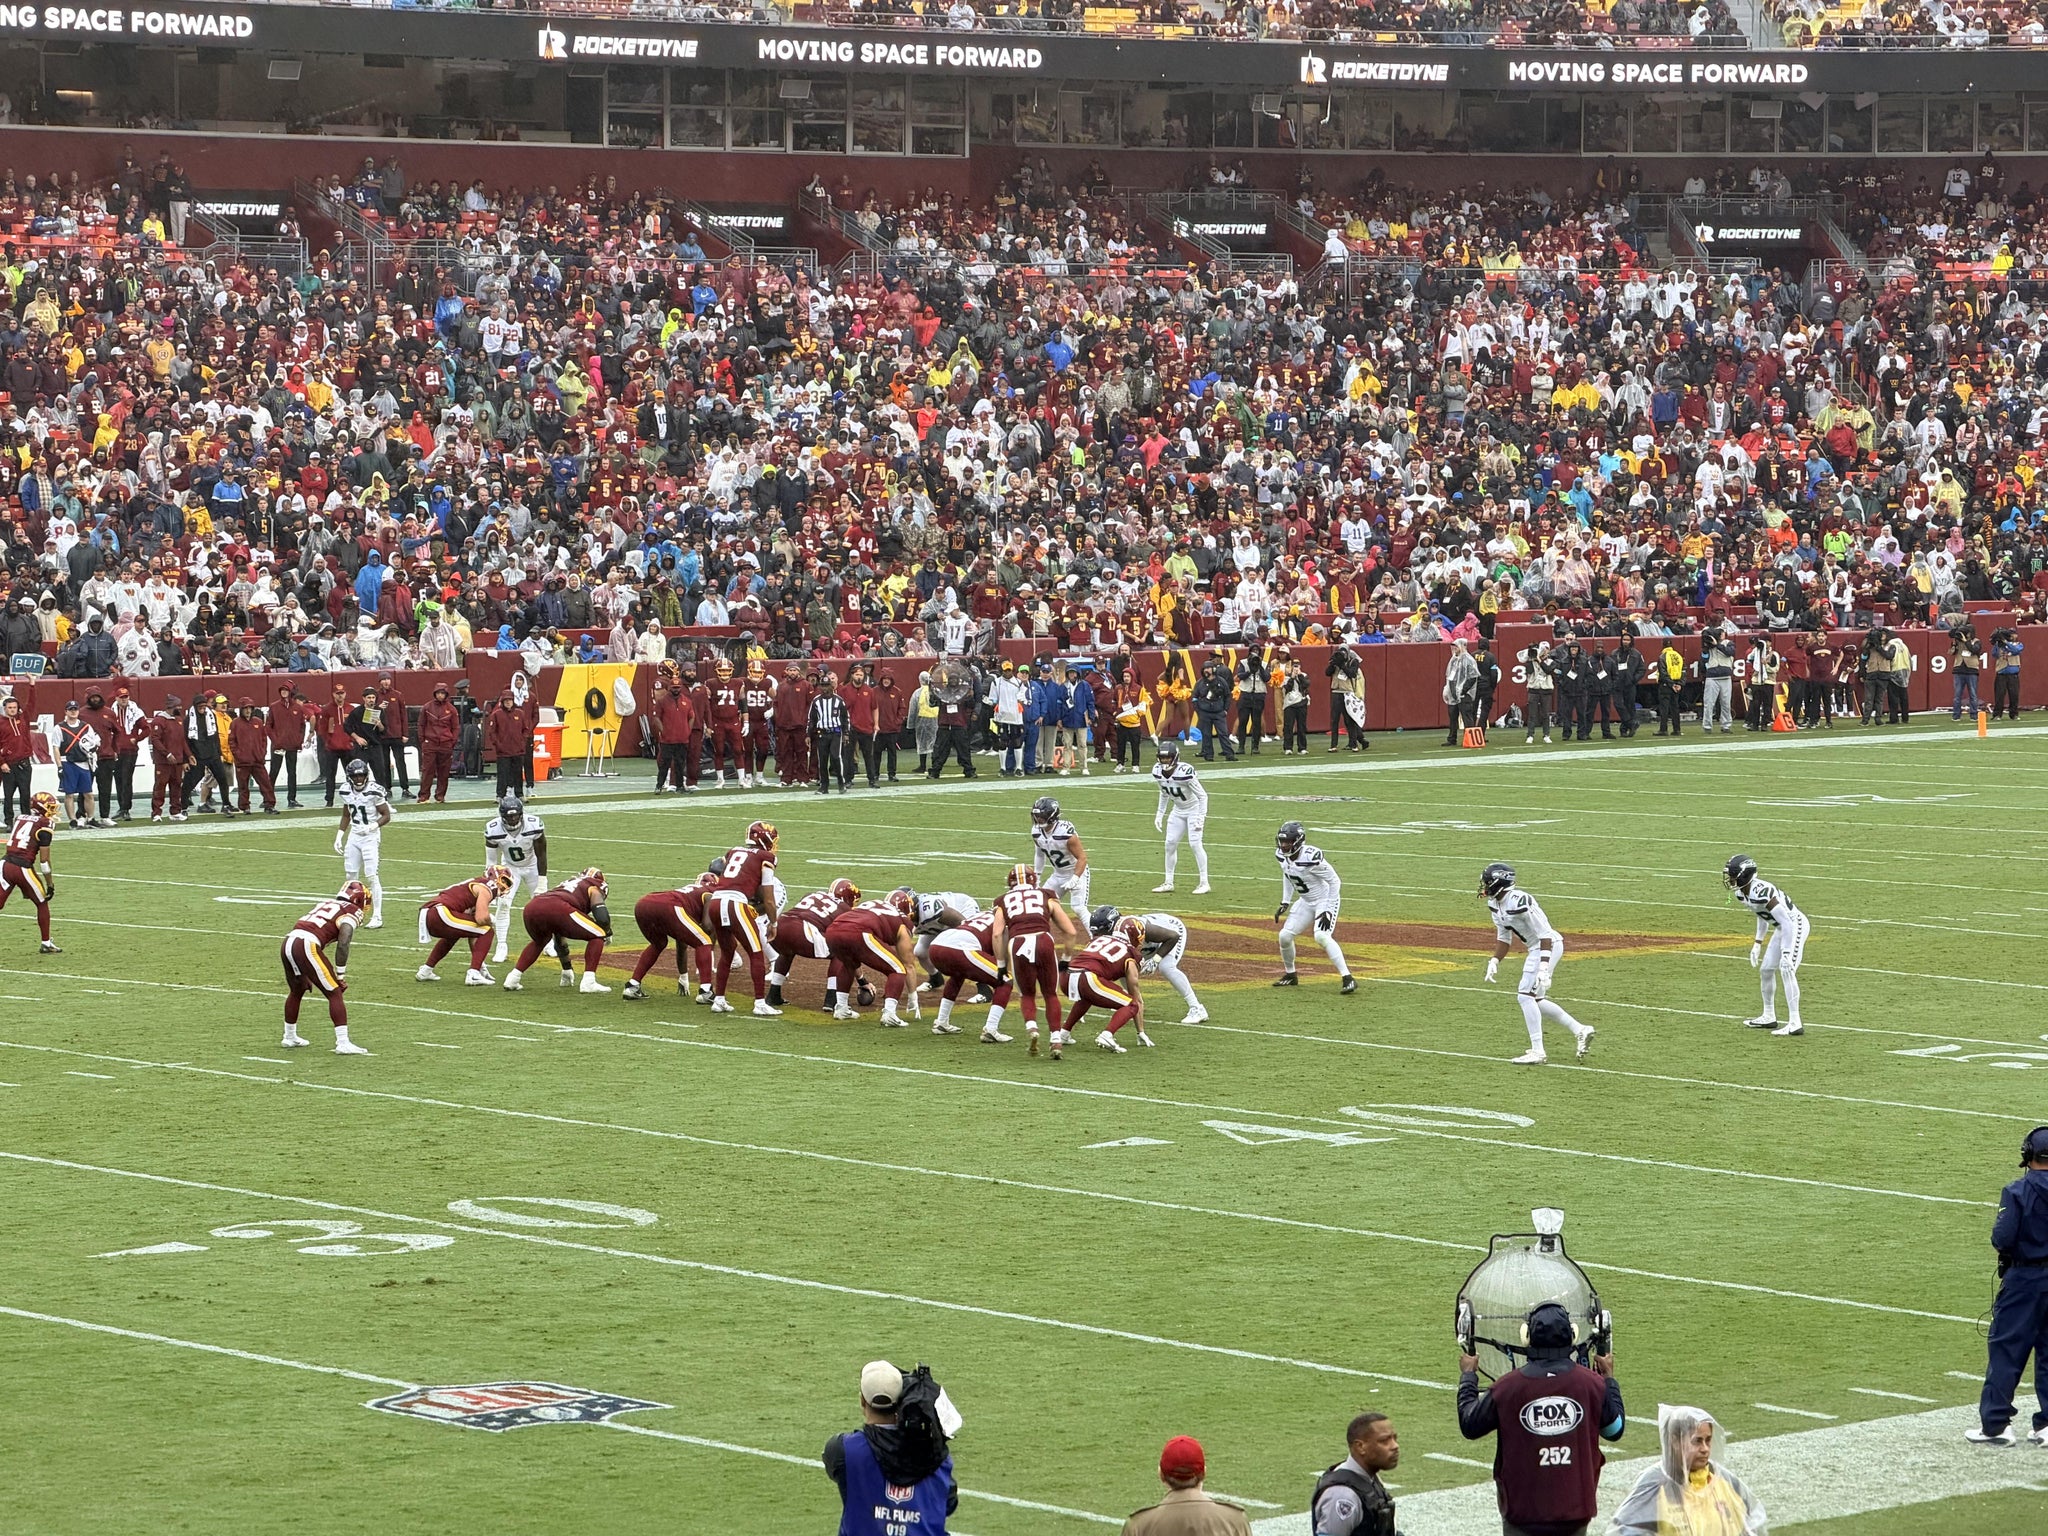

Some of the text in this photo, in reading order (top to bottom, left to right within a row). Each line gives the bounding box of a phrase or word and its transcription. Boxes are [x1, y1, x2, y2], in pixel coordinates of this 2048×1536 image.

[44, 10, 124, 33] SPACE
[131, 12, 254, 38] FORWARD
[758, 38, 1043, 69] MOVING SPACE FORWARD
[1331, 61, 1449, 81] ROCKETDYNE
[1509, 61, 1809, 84] MOVING SPACE FORWARD
[1718, 229, 1802, 240] ROCKETDYNE
[322, 269, 328, 280] 9
[678, 277, 686, 289] 5
[1834, 281, 1842, 292] 9
[727, 299, 734, 310] 5
[489, 324, 500, 335] 81
[1797, 362, 1808, 375] 17
[425, 372, 440, 385] 21
[1285, 372, 1290, 384] 5
[1310, 374, 1316, 386] 5
[1716, 407, 1722, 417] 5
[1772, 406, 1784, 416] 26
[1275, 419, 1282, 430] 11
[125, 440, 137, 450] 28
[1586, 437, 1598, 449] 41
[1771, 468, 1776, 480] 5
[603, 484, 610, 497] 5
[631, 480, 638, 491] 5
[1941, 489, 1954, 500] 32
[262, 521, 267, 533] 5
[1353, 528, 1361, 539] 11
[858, 538, 873, 552] 44
[1605, 544, 1616, 556] 21
[154, 592, 164, 600] W
[1249, 590, 1260, 602] 21
[907, 603, 914, 616] 5
[1777, 601, 1785, 611] 17
[1147, 608, 1153, 622] 4
[950, 626, 960, 640] 17
[1134, 621, 1140, 635] 5
[15, 659, 41, 675] BUF
[717, 690, 736, 706] 71
[1783, 714, 1795, 729] G
[1468, 728, 1483, 747] 10
[350, 804, 369, 825] 21
[7, 820, 34, 849] 14
[508, 847, 525, 862] 0
[723, 851, 749, 878] 8
[1752, 882, 1765, 894] 29
[795, 892, 838, 919] 63
[1003, 890, 1044, 918] 82
[1084, 936, 1128, 963] 80
[1200, 1103, 1535, 1147] 40
[209, 1197, 658, 1256] 30
[1532, 1403, 1569, 1421] FOX
[1534, 1419, 1571, 1428] SPORTS
[1539, 1446, 1571, 1466] 252
[874, 1506, 921, 1524] NFL FILMS
[886, 1523, 907, 1536] 019
